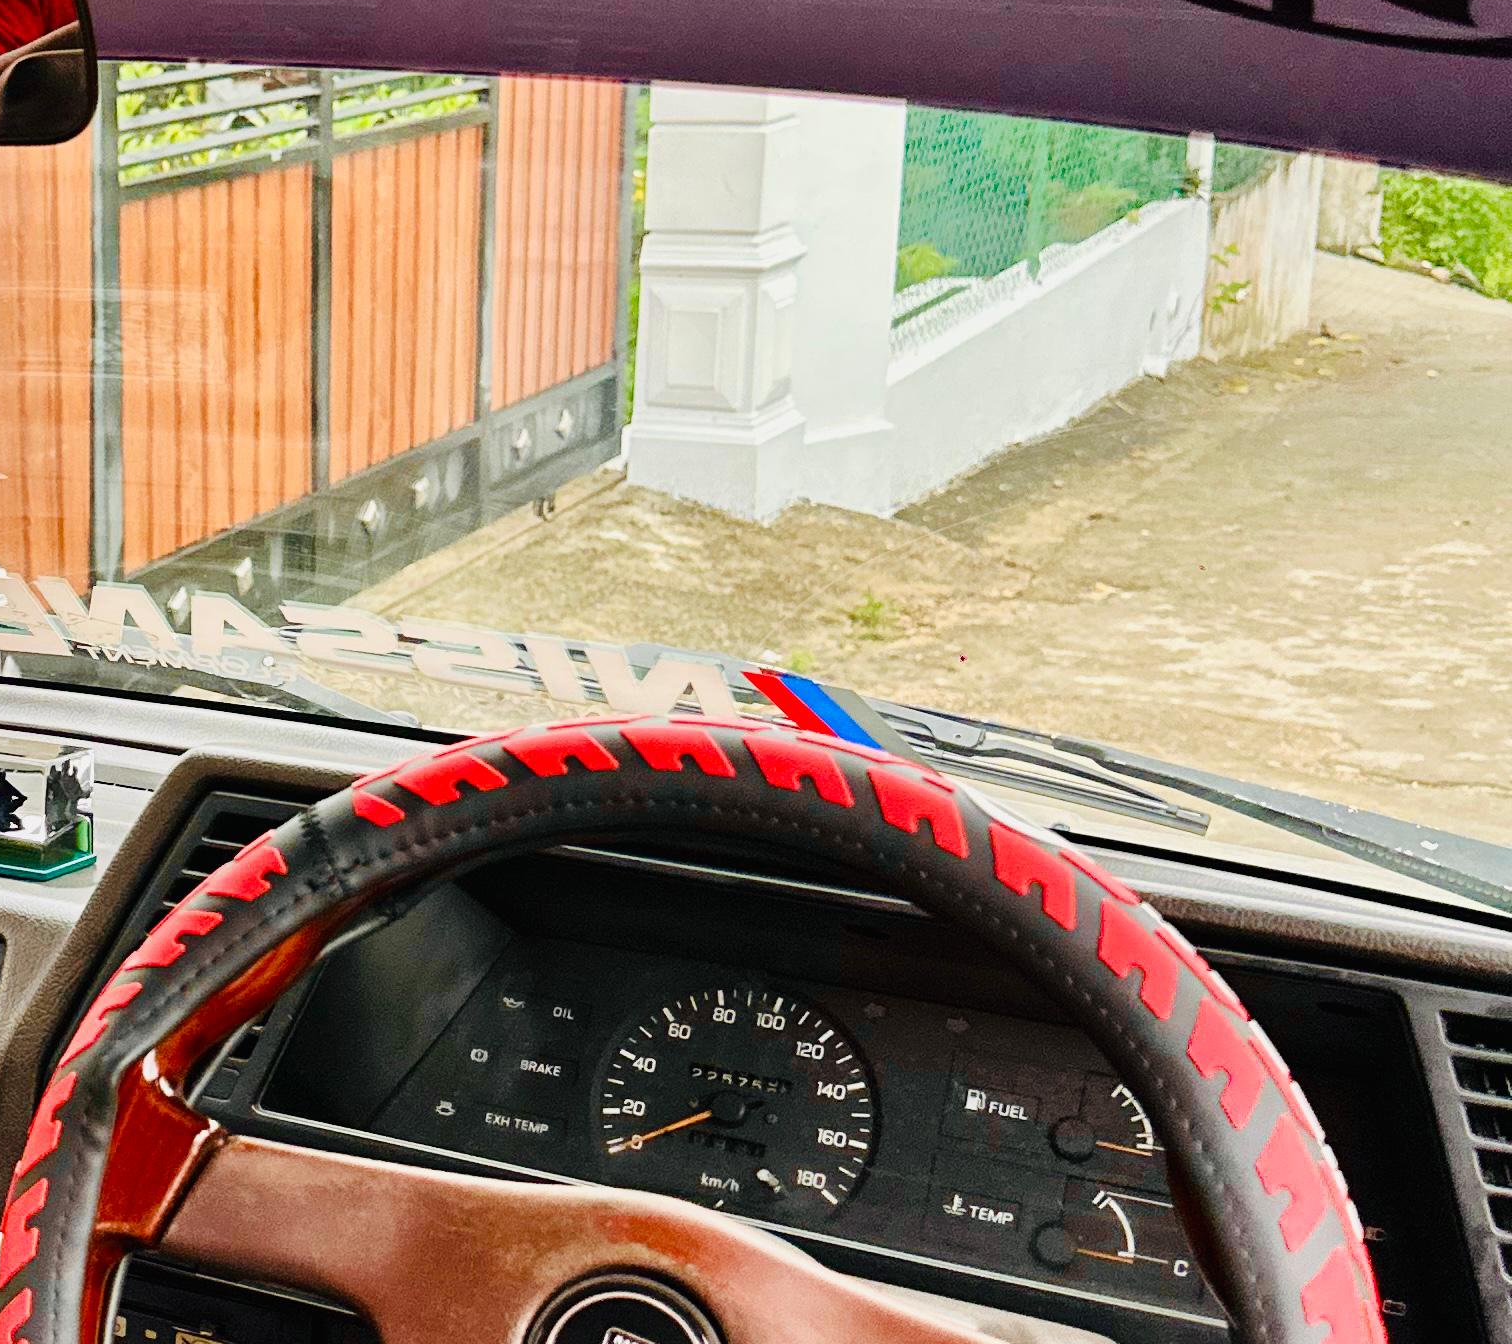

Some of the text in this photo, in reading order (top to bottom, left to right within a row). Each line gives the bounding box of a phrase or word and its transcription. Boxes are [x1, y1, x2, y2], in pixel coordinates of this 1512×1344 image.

[552, 1006, 575, 1021] OIL
[711, 1007, 737, 1025] 80
[756, 1011, 786, 1031] 100
[667, 1023, 692, 1041] 60
[795, 1040, 825, 1061] 120
[519, 1059, 562, 1078] BRAKE
[632, 1056, 657, 1074] 40
[815, 1080, 847, 1101] 140
[621, 1099, 646, 1117] 20
[987, 1100, 1029, 1122] FUEL
[484, 1111, 550, 1136] EXH TEMP
[815, 1127, 848, 1148] 160
[699, 1171, 741, 1193] km/h
[795, 1167, 826, 1189] 180
[968, 1205, 1015, 1226] TEMP
[1172, 1258, 1190, 1278] C
